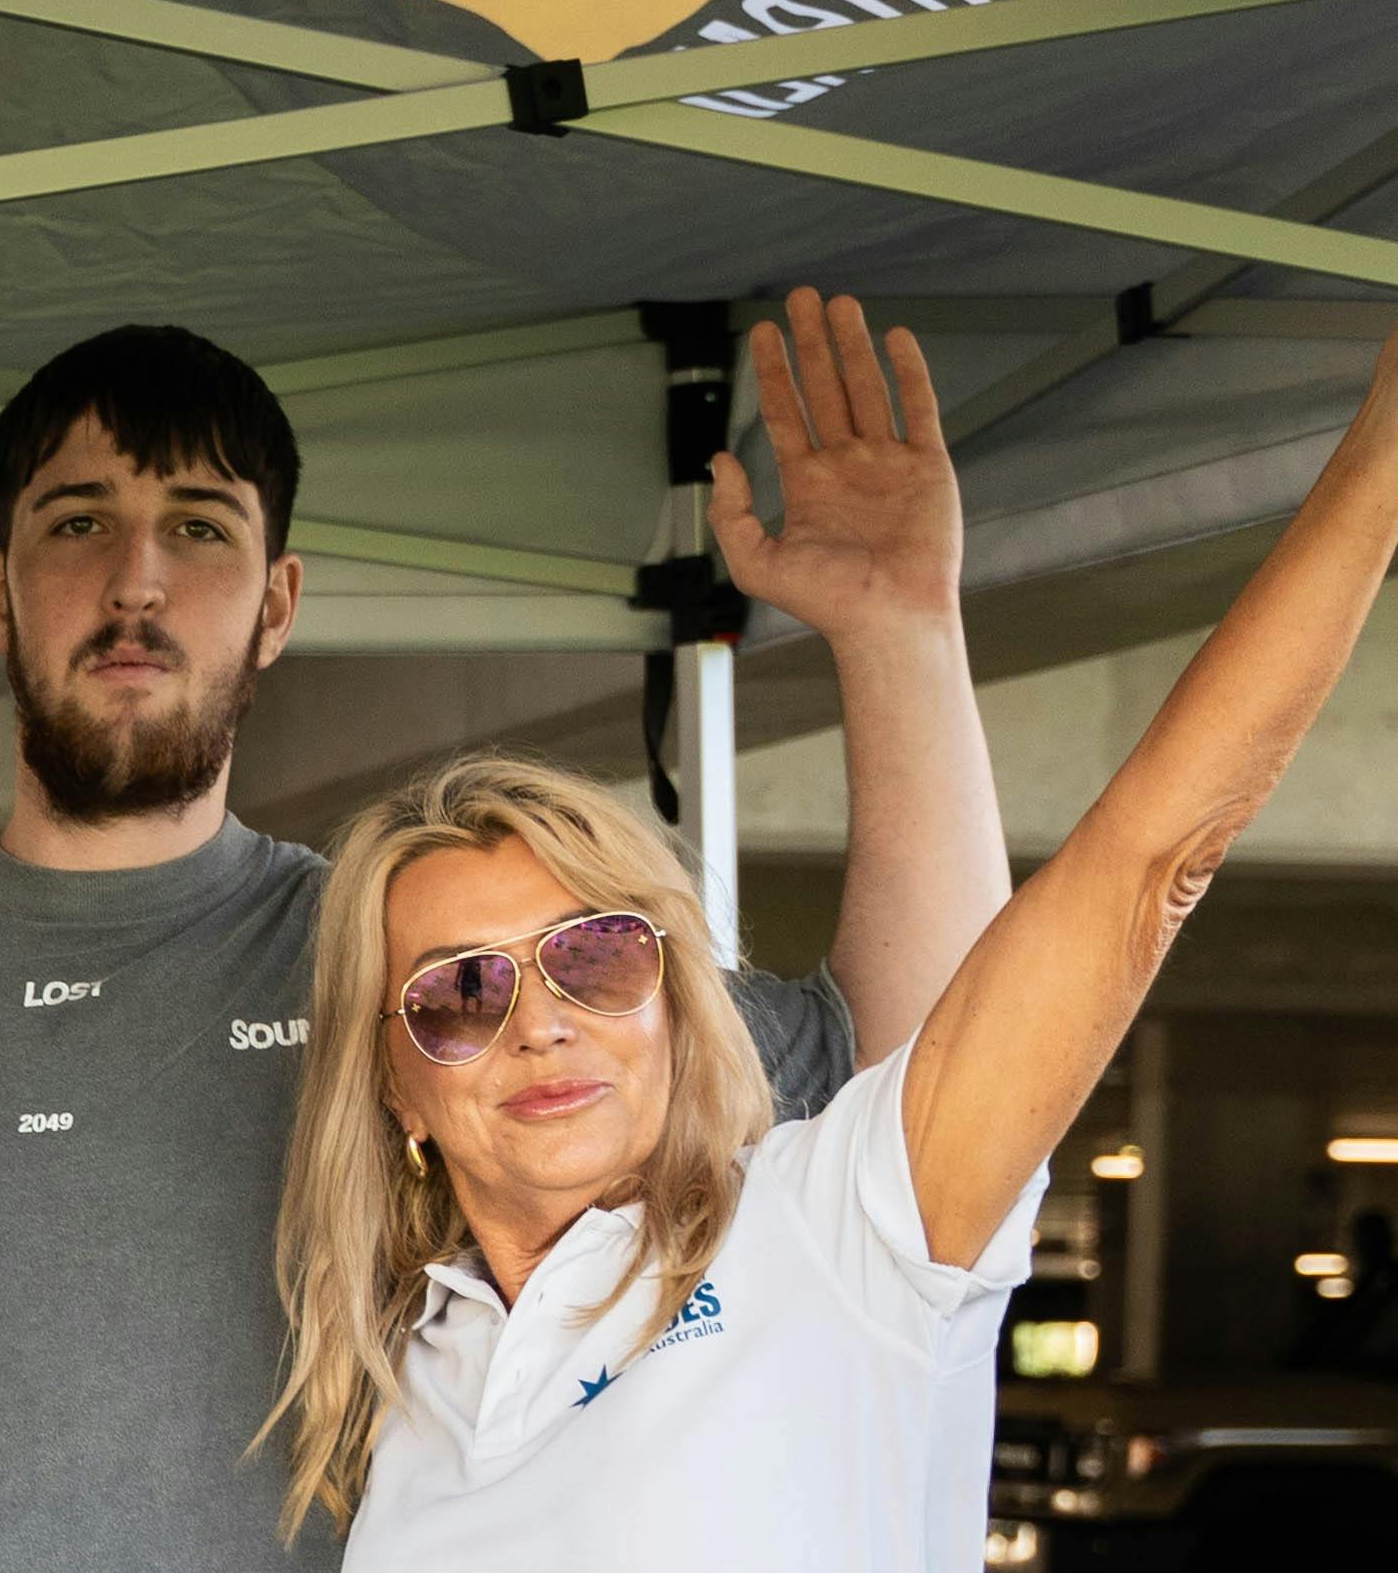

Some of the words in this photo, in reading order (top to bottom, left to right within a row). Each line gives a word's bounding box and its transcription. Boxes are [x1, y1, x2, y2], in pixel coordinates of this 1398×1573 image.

[23, 979, 103, 1008] LOST
[17, 1111, 74, 1134] 2049
[649, 1320, 725, 1353] ustralia
